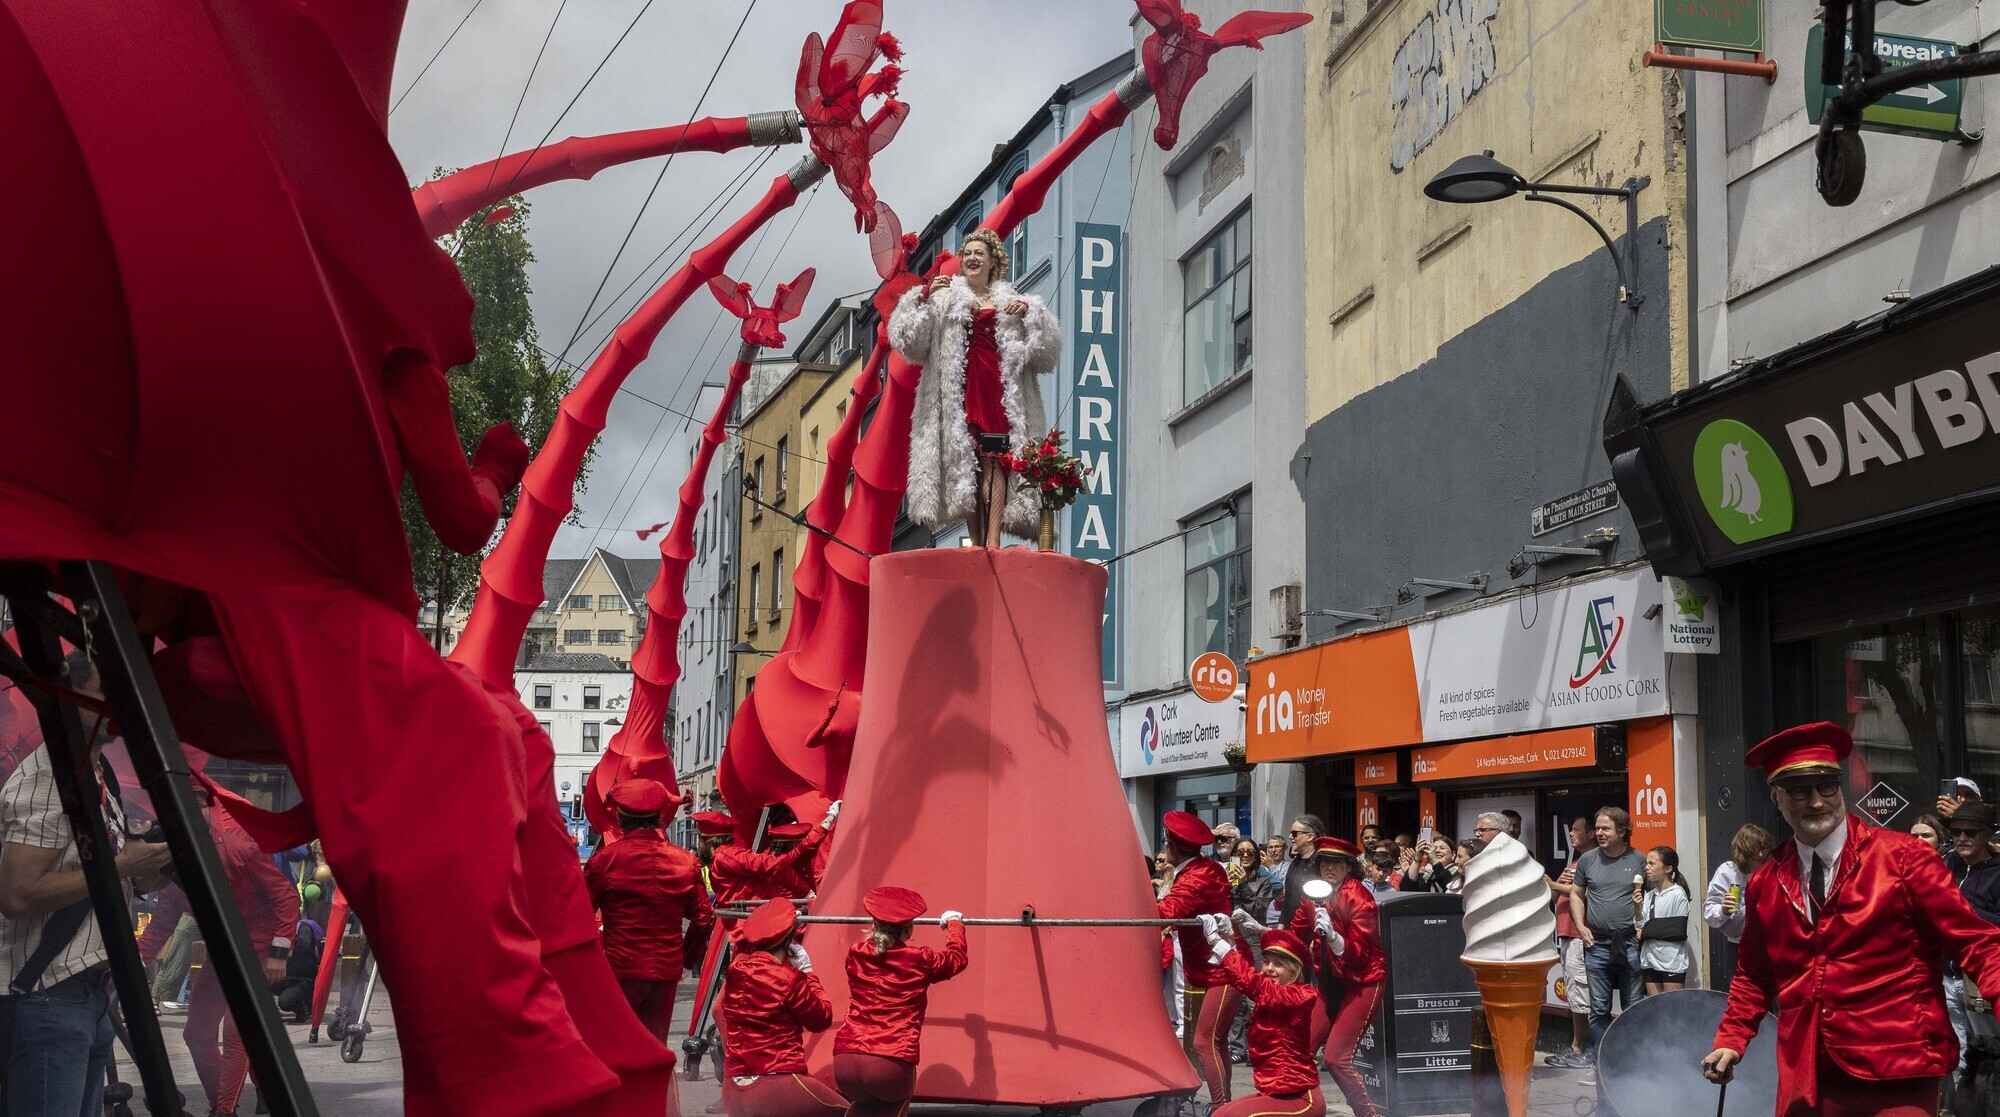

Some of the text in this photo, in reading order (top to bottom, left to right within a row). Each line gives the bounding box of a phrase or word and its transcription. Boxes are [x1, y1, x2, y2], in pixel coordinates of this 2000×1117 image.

[1549, 496, 1607, 526] NORTH MAIN STREET
[1670, 624, 1715, 634] National
[1673, 634, 1712, 647] Lottery
[1196, 658, 1232, 686] ria
[1196, 684, 1231, 694] Money Transfer
[1296, 687, 1326, 706] Money
[1439, 687, 1495, 705] All kind of spices
[1549, 678, 1661, 707] ASIAN FOODS CORK
[1161, 701, 1178, 721] Cork
[1256, 671, 1294, 735] ria
[1439, 698, 1530, 722] Fresh vegetables available
[1296, 706, 1332, 728] Transfer
[1161, 723, 1220, 748] Volunteer Centre
[1476, 758, 1483, 768] 14
[1483, 757, 1497, 768] North
[1497, 756, 1509, 767] Main
[1526, 752, 1539, 763] Cork
[1549, 746, 1586, 760] 021 4279142
[1365, 760, 1376, 778] ria
[1414, 754, 1427, 774] ria
[1636, 774, 1668, 816] ria
[1867, 797, 1897, 808] MUNCH
[1359, 798, 1376, 826] ria
[1422, 809, 1434, 828] ria
[1636, 820, 1668, 829] Money Transfer
[1417, 999, 1460, 1008] Bruscar
[1425, 1056, 1458, 1067] Litter
[1364, 1073, 1381, 1088] Cork
